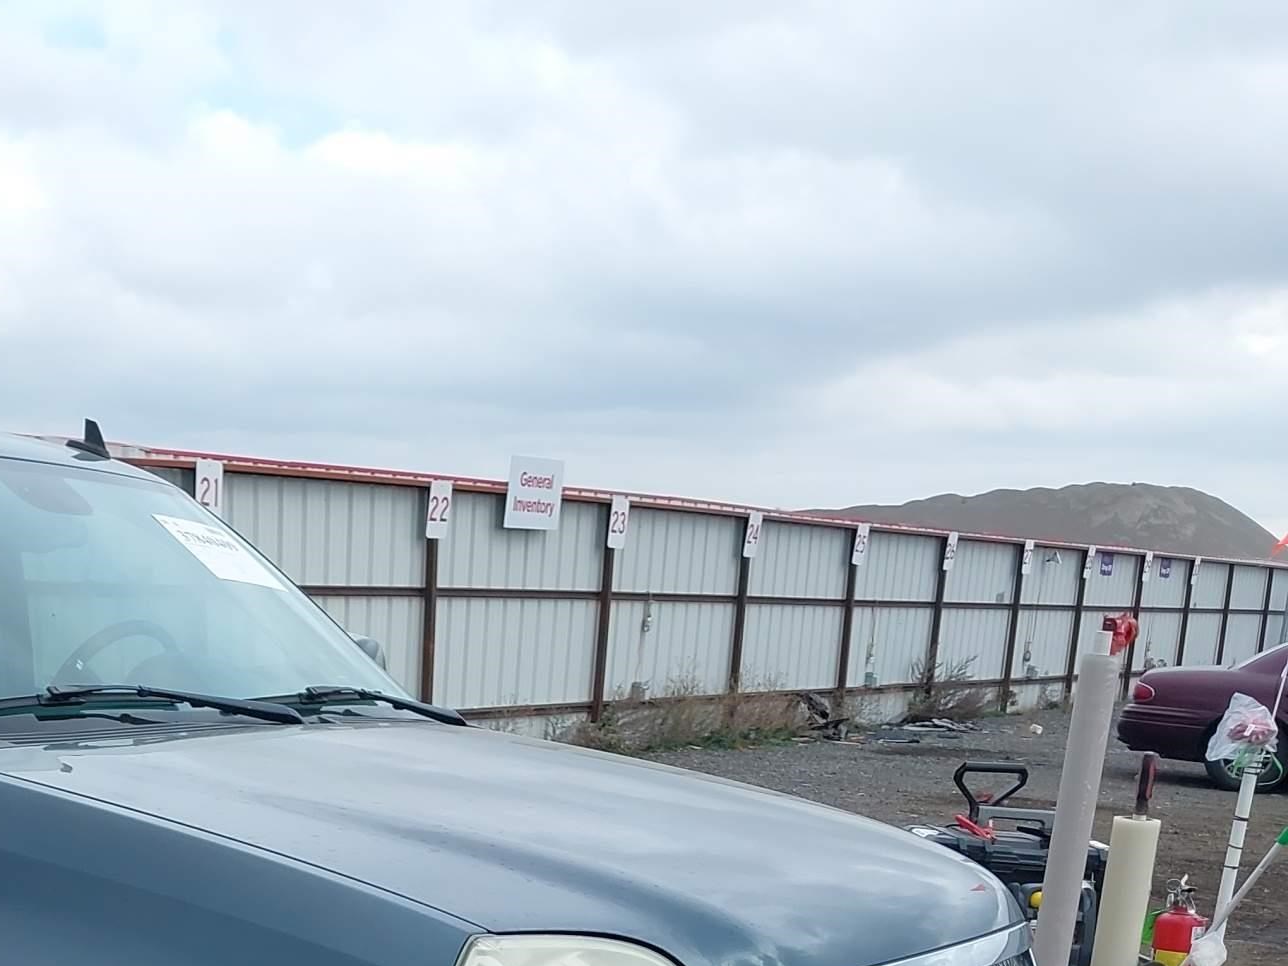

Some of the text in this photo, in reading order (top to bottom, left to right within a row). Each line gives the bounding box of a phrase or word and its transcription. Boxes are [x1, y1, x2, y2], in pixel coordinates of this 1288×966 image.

[200, 476, 219, 507] 21
[520, 472, 555, 490] General
[429, 496, 450, 522] 22
[513, 496, 556, 518] Inventory
[611, 511, 627, 534] 23
[746, 524, 760, 544] 24
[855, 534, 867, 553] 25
